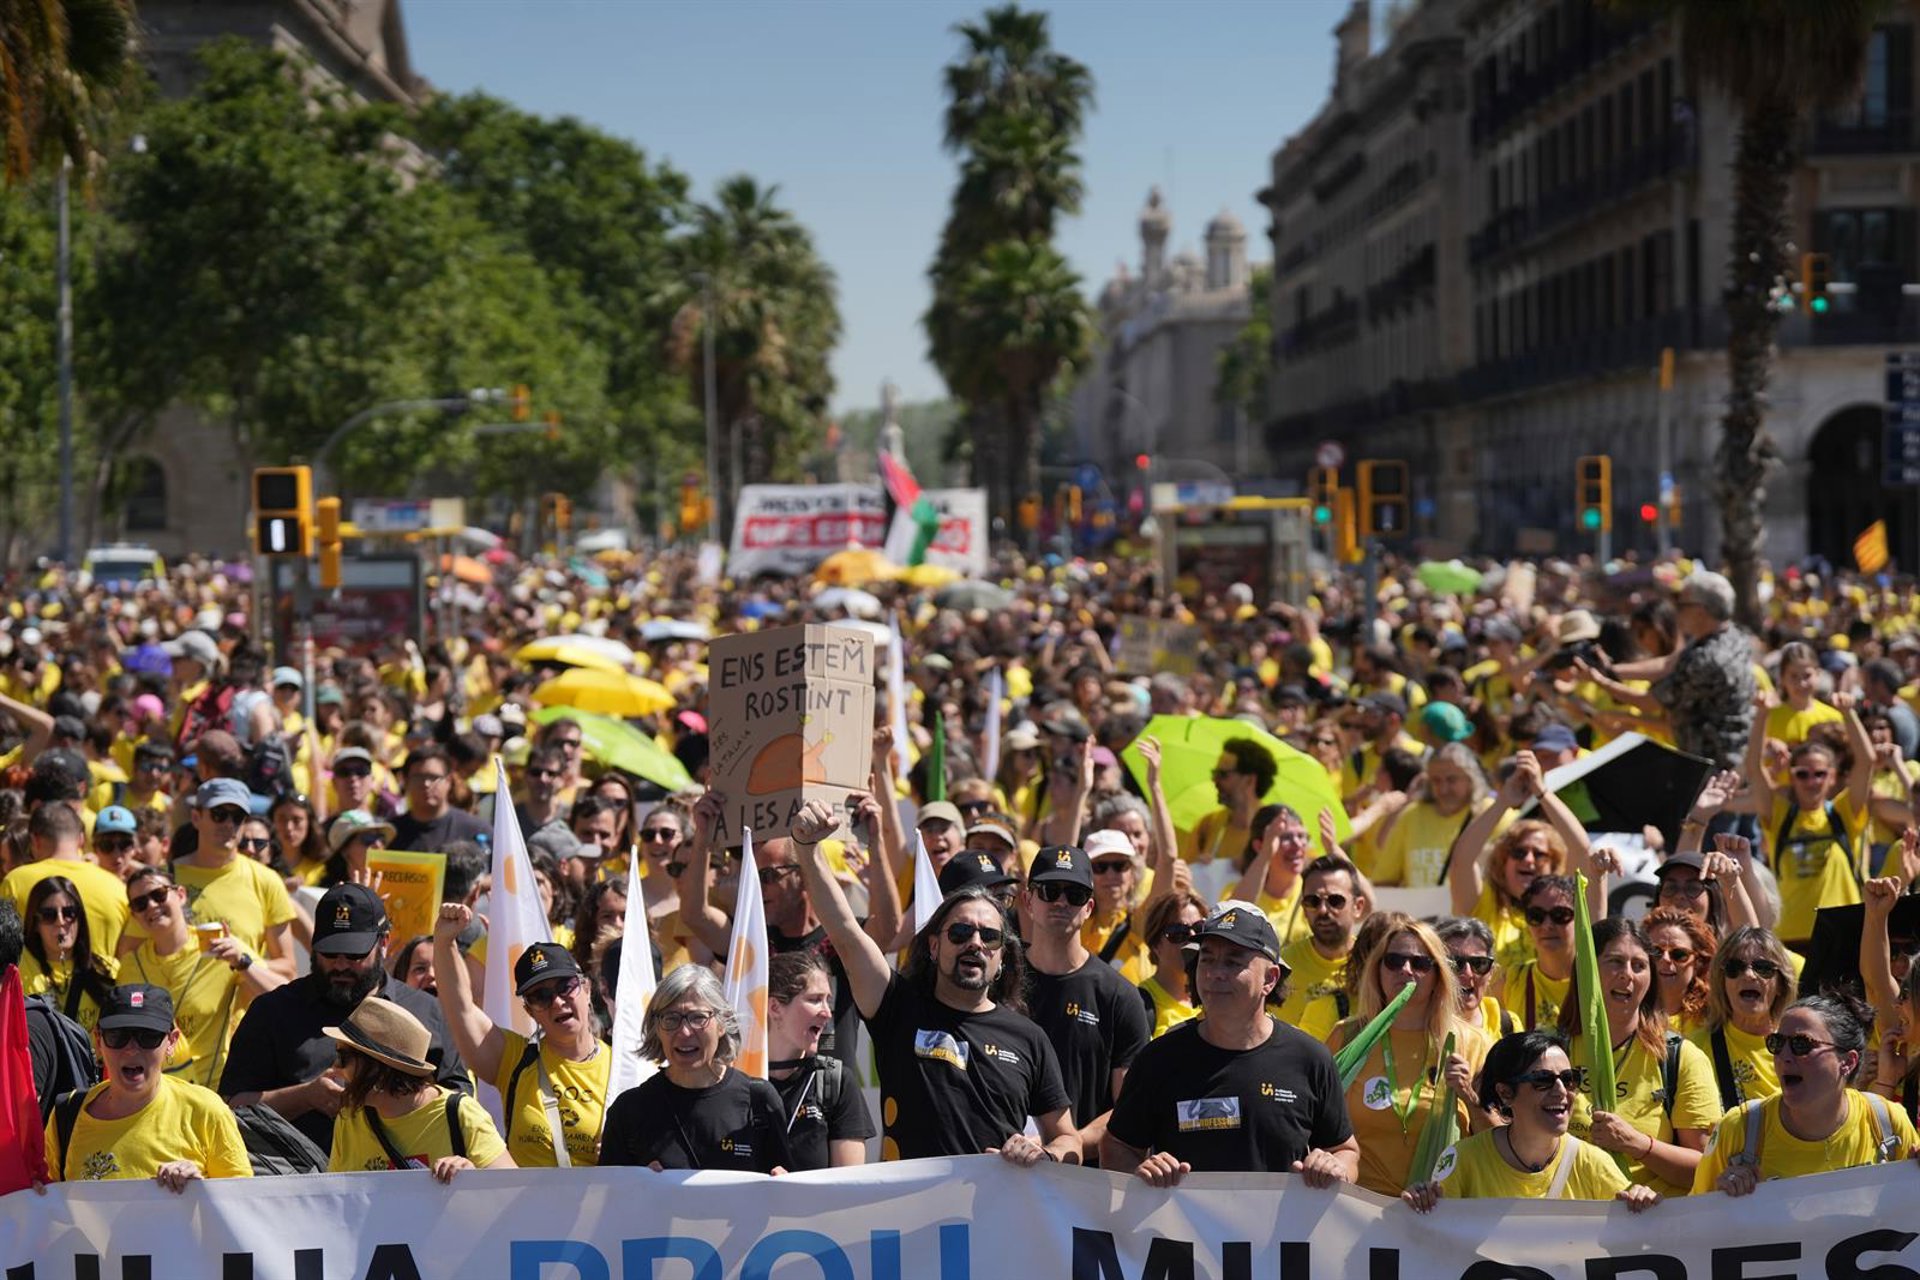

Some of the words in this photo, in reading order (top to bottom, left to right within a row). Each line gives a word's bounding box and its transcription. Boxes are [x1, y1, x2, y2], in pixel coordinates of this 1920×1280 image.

[721, 653, 764, 688] ENS
[775, 643, 865, 677] ESTEM
[552, 1084, 593, 1103] SOS
